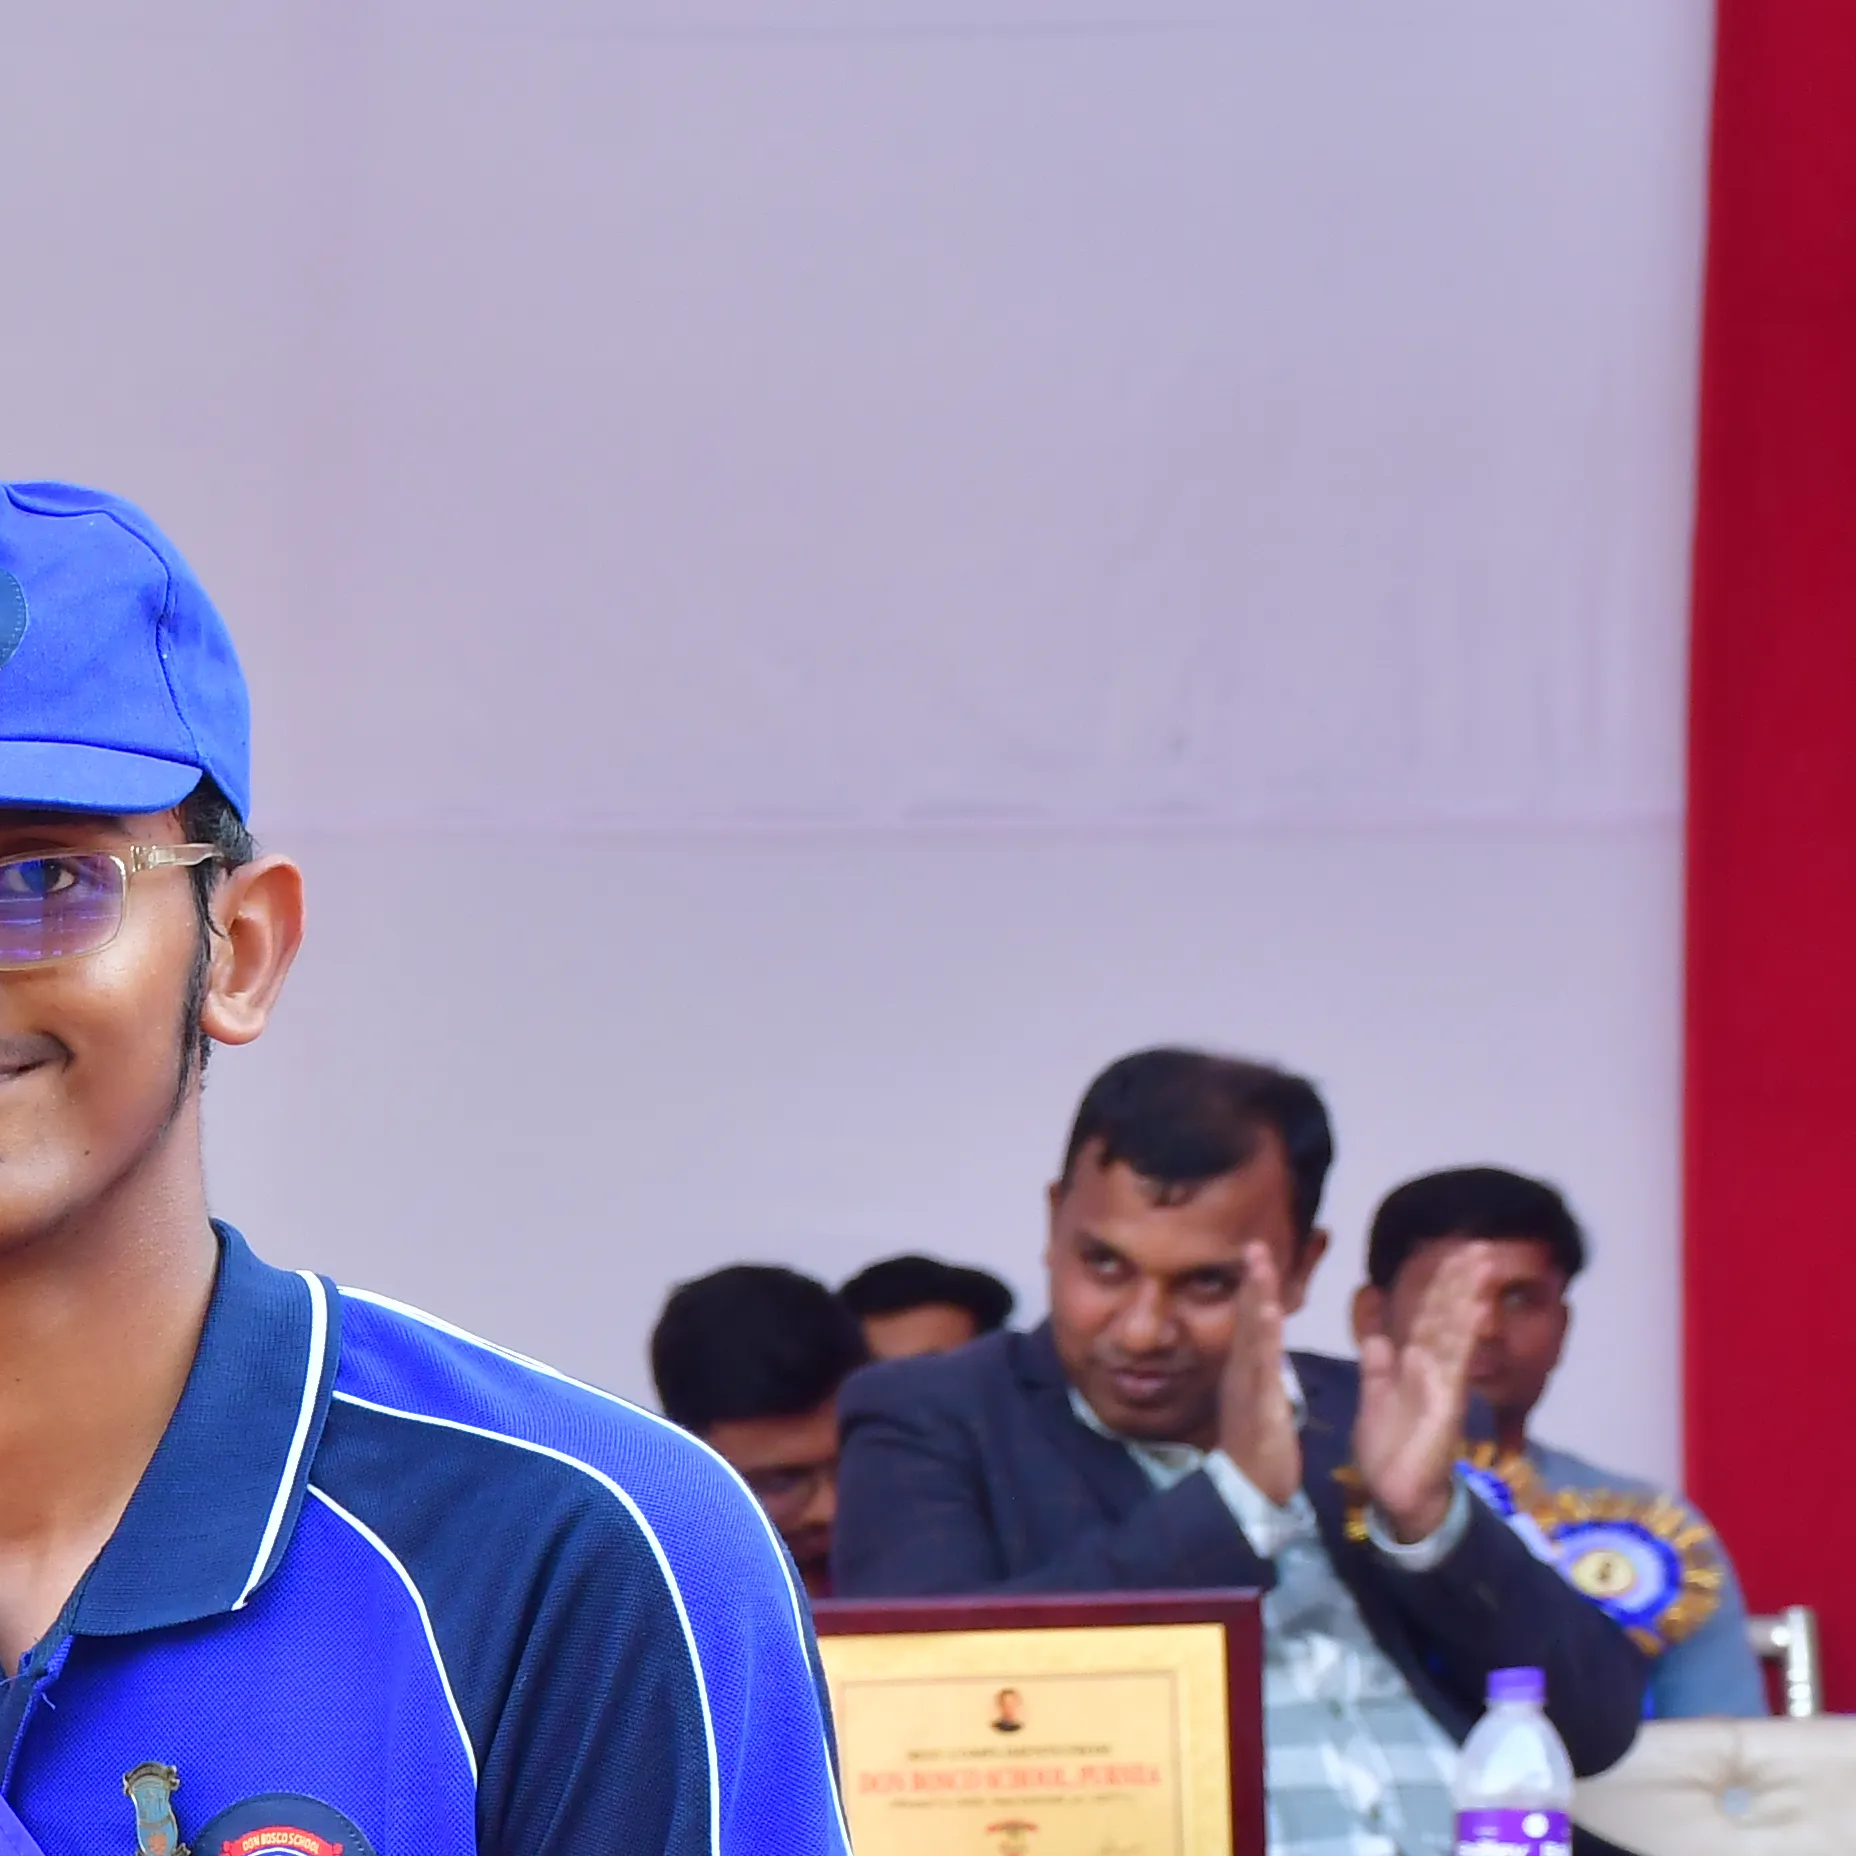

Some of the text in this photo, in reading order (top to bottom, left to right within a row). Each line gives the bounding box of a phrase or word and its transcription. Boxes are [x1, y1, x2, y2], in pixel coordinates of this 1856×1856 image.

[242, 1832, 320, 1855] DON BOSCO SCHOOL
